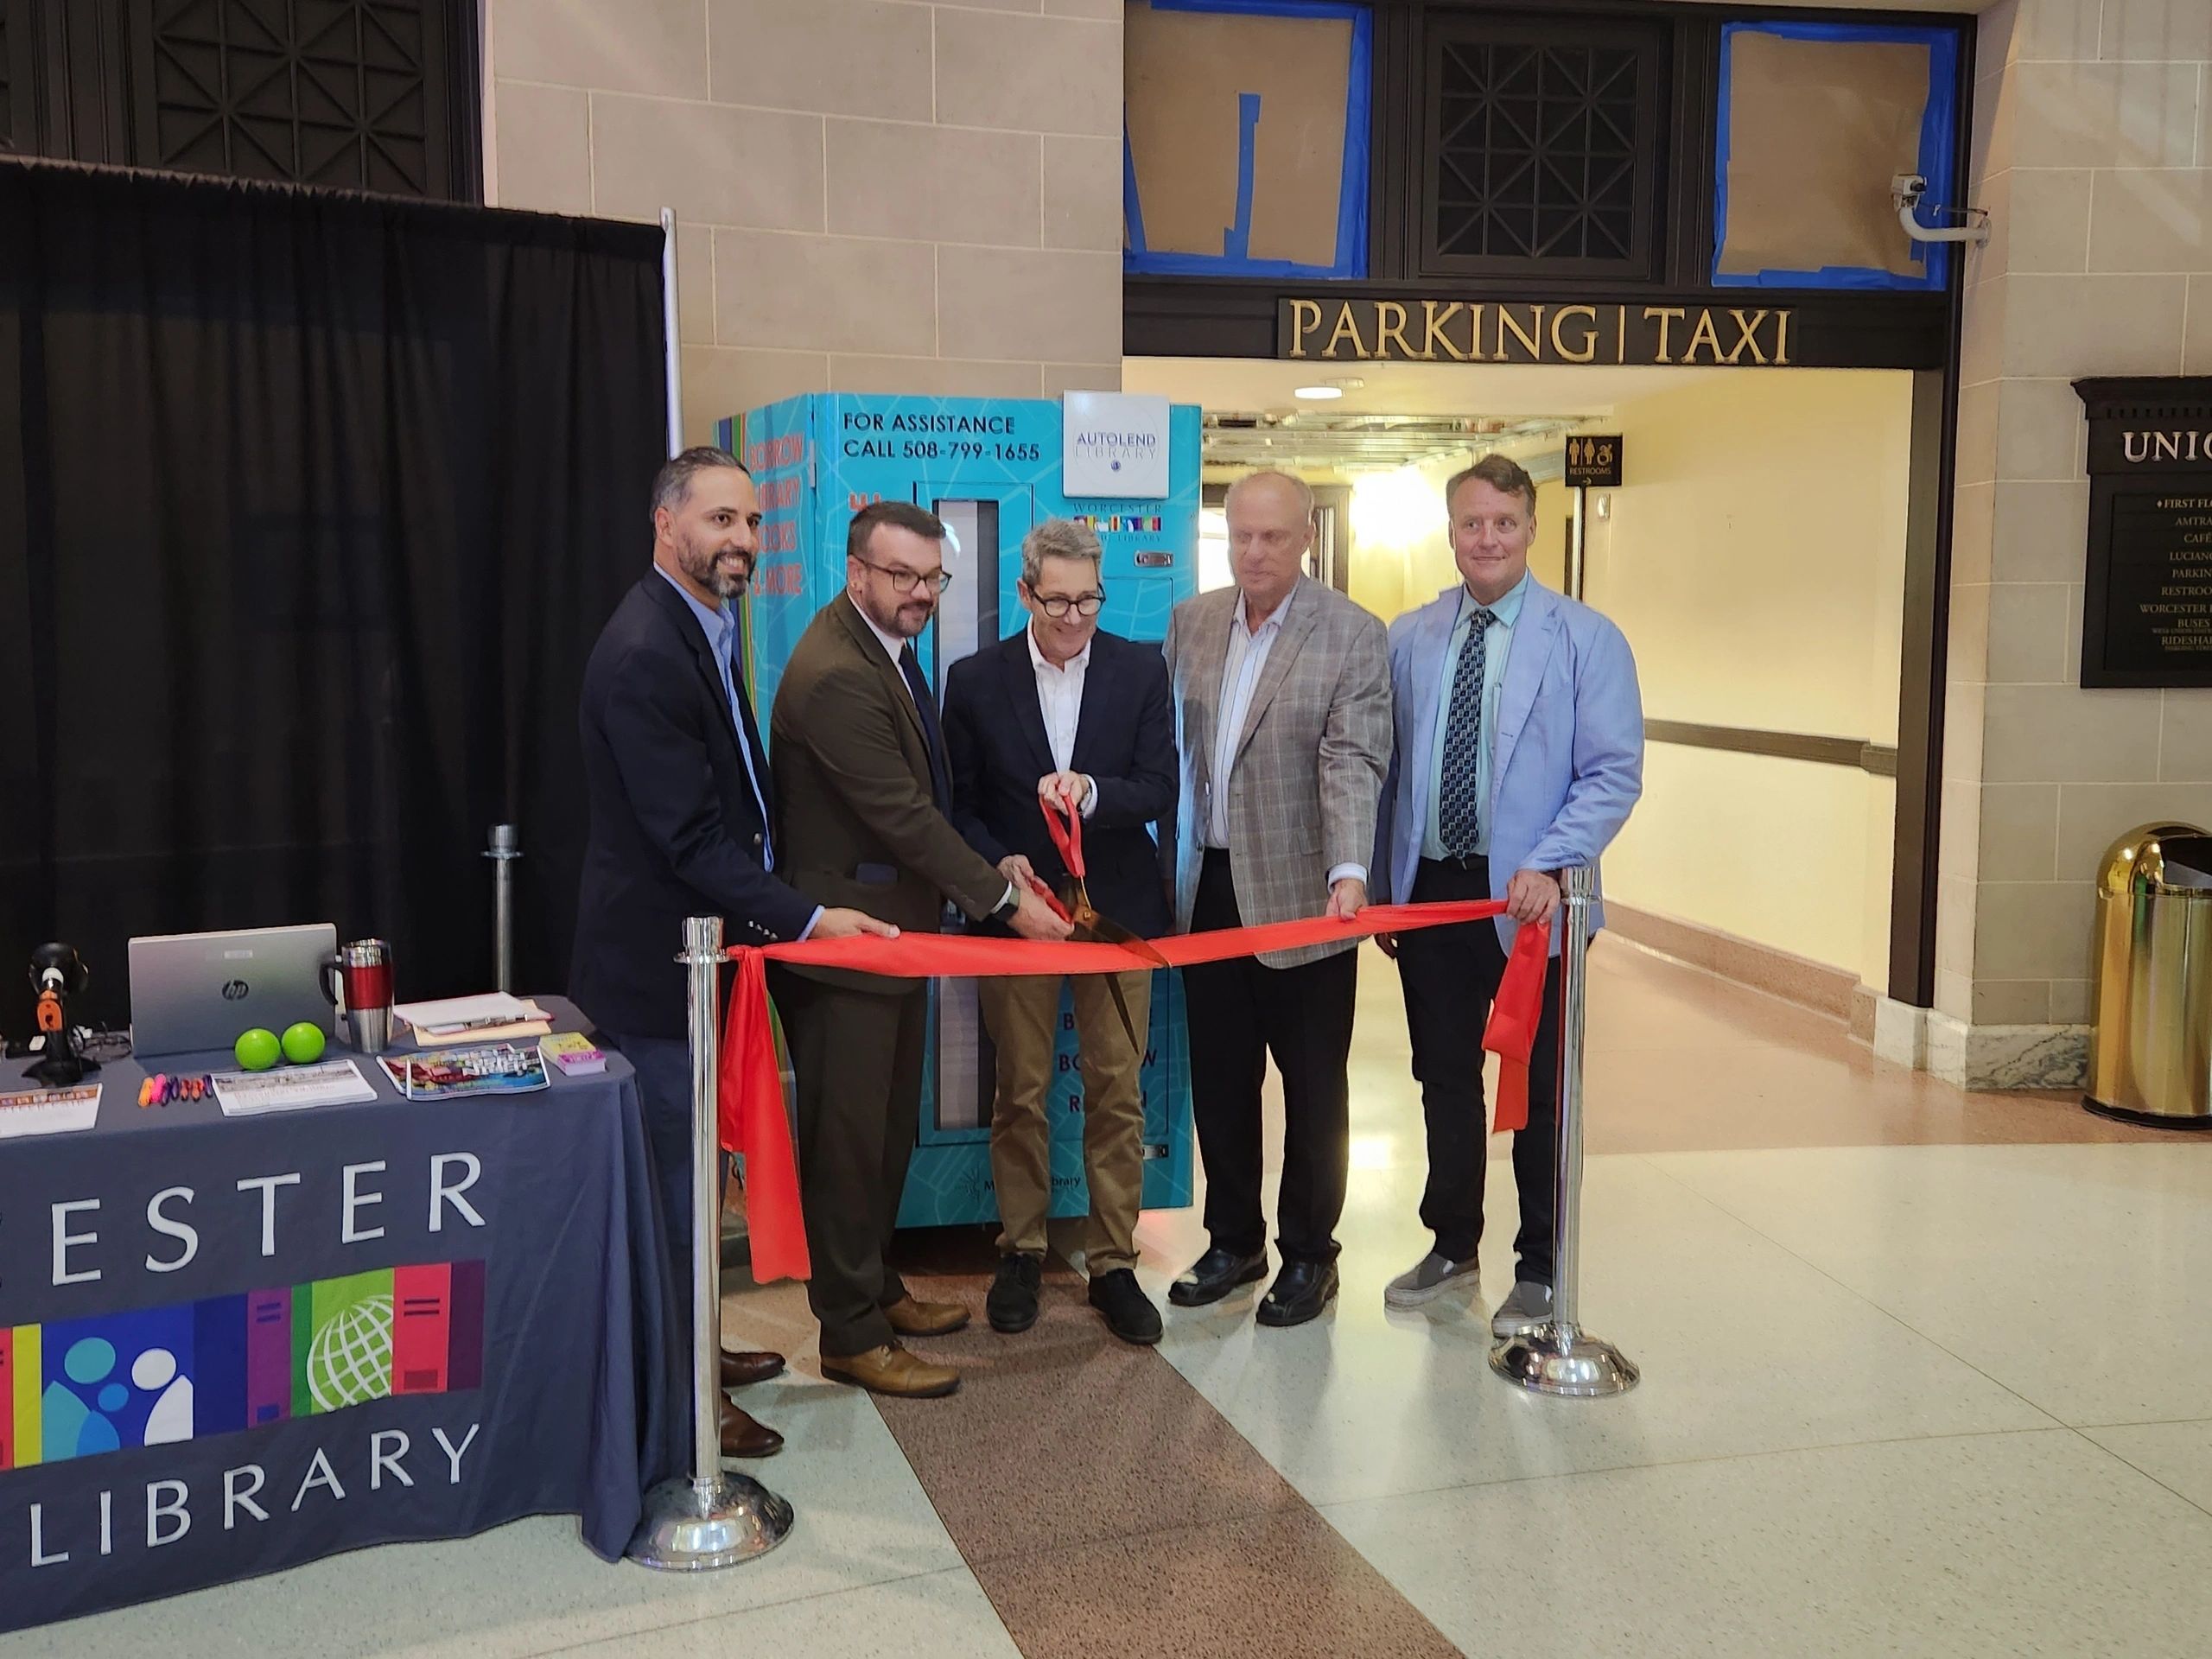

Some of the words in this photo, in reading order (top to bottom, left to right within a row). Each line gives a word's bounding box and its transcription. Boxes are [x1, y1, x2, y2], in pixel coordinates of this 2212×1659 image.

[1289, 299, 1597, 363] PARKING
[1643, 307, 1791, 365] TAXI
[843, 412, 884, 431] FOR
[892, 414, 1015, 435] ASSISTANCE
[843, 439, 895, 458] CALL
[903, 440, 1039, 461] 508-799-1655
[1077, 431, 1156, 448] AUTOLEND
[2121, 430, 2212, 463] UNI
[749, 435, 804, 472] BORROW
[1074, 446, 1156, 460] LIBRARY
[1569, 467, 1612, 476] RESTROOMS
[1073, 503, 1162, 514] WORCESTER
[2164, 499, 2196, 509] FIRST
[759, 522, 797, 554] OOKS
[766, 563, 803, 596] MORE
[2139, 604, 2207, 613] WORCESTER
[2177, 618, 2210, 628] BUSES
[50, 1151, 486, 1286] ESTER
[30, 1423, 480, 1567] LIBRARY
